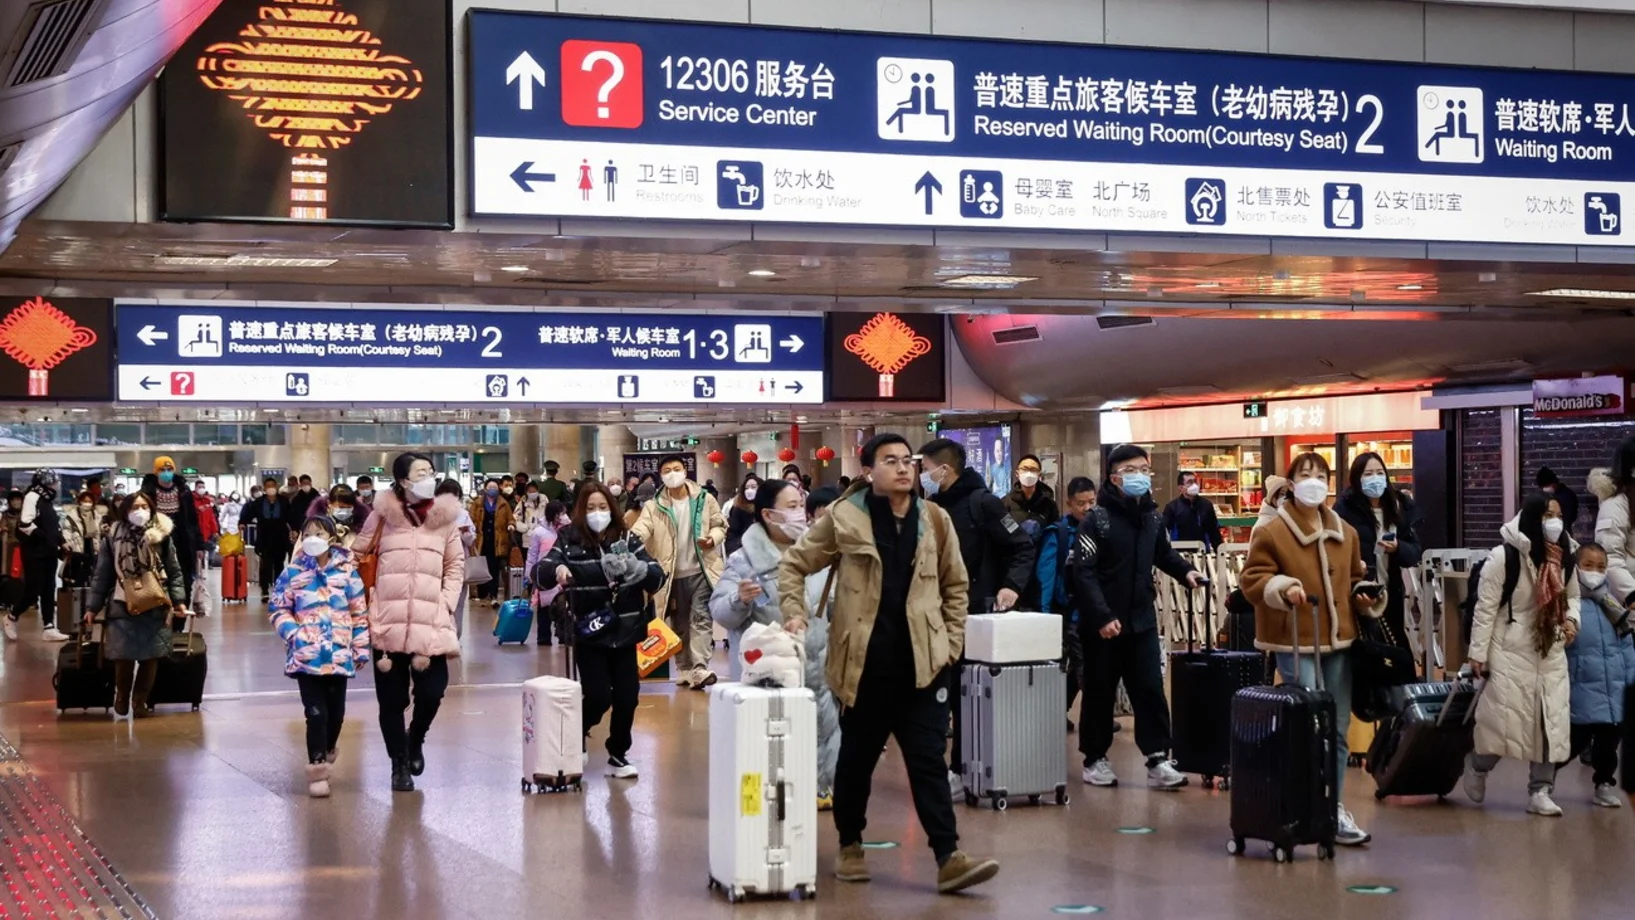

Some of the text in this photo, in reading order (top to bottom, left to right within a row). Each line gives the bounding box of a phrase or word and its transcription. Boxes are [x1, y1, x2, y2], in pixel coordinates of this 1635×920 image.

[661, 56, 835, 99] 12306 服务台
[659, 100, 817, 126] Service Center
[975, 115, 1067, 138] Reserved
[1073, 120, 1143, 146] Waiting
[1355, 95, 1384, 154] 2
[1495, 138, 1612, 162] Waiting Room
[637, 164, 698, 186] 卫生间
[774, 168, 834, 190] 饮水处
[1015, 178, 1073, 199] 母婴室
[1093, 181, 1150, 202] 北广场
[1237, 186, 1310, 207] 北售票处
[774, 193, 862, 209] Drinking Water
[1014, 203, 1076, 218] Baby Care
[1375, 191, 1462, 211] 公安值班室
[1526, 196, 1574, 214] 饮水处
[1092, 205, 1167, 220] North Square
[1237, 211, 1307, 222] North Tickets
[229, 342, 282, 353] Reserved
[284, 343, 325, 356] Waiting
[481, 327, 502, 357] 2
[612, 347, 680, 359] Waiting Room
[1534, 394, 1603, 412] McDonald's
